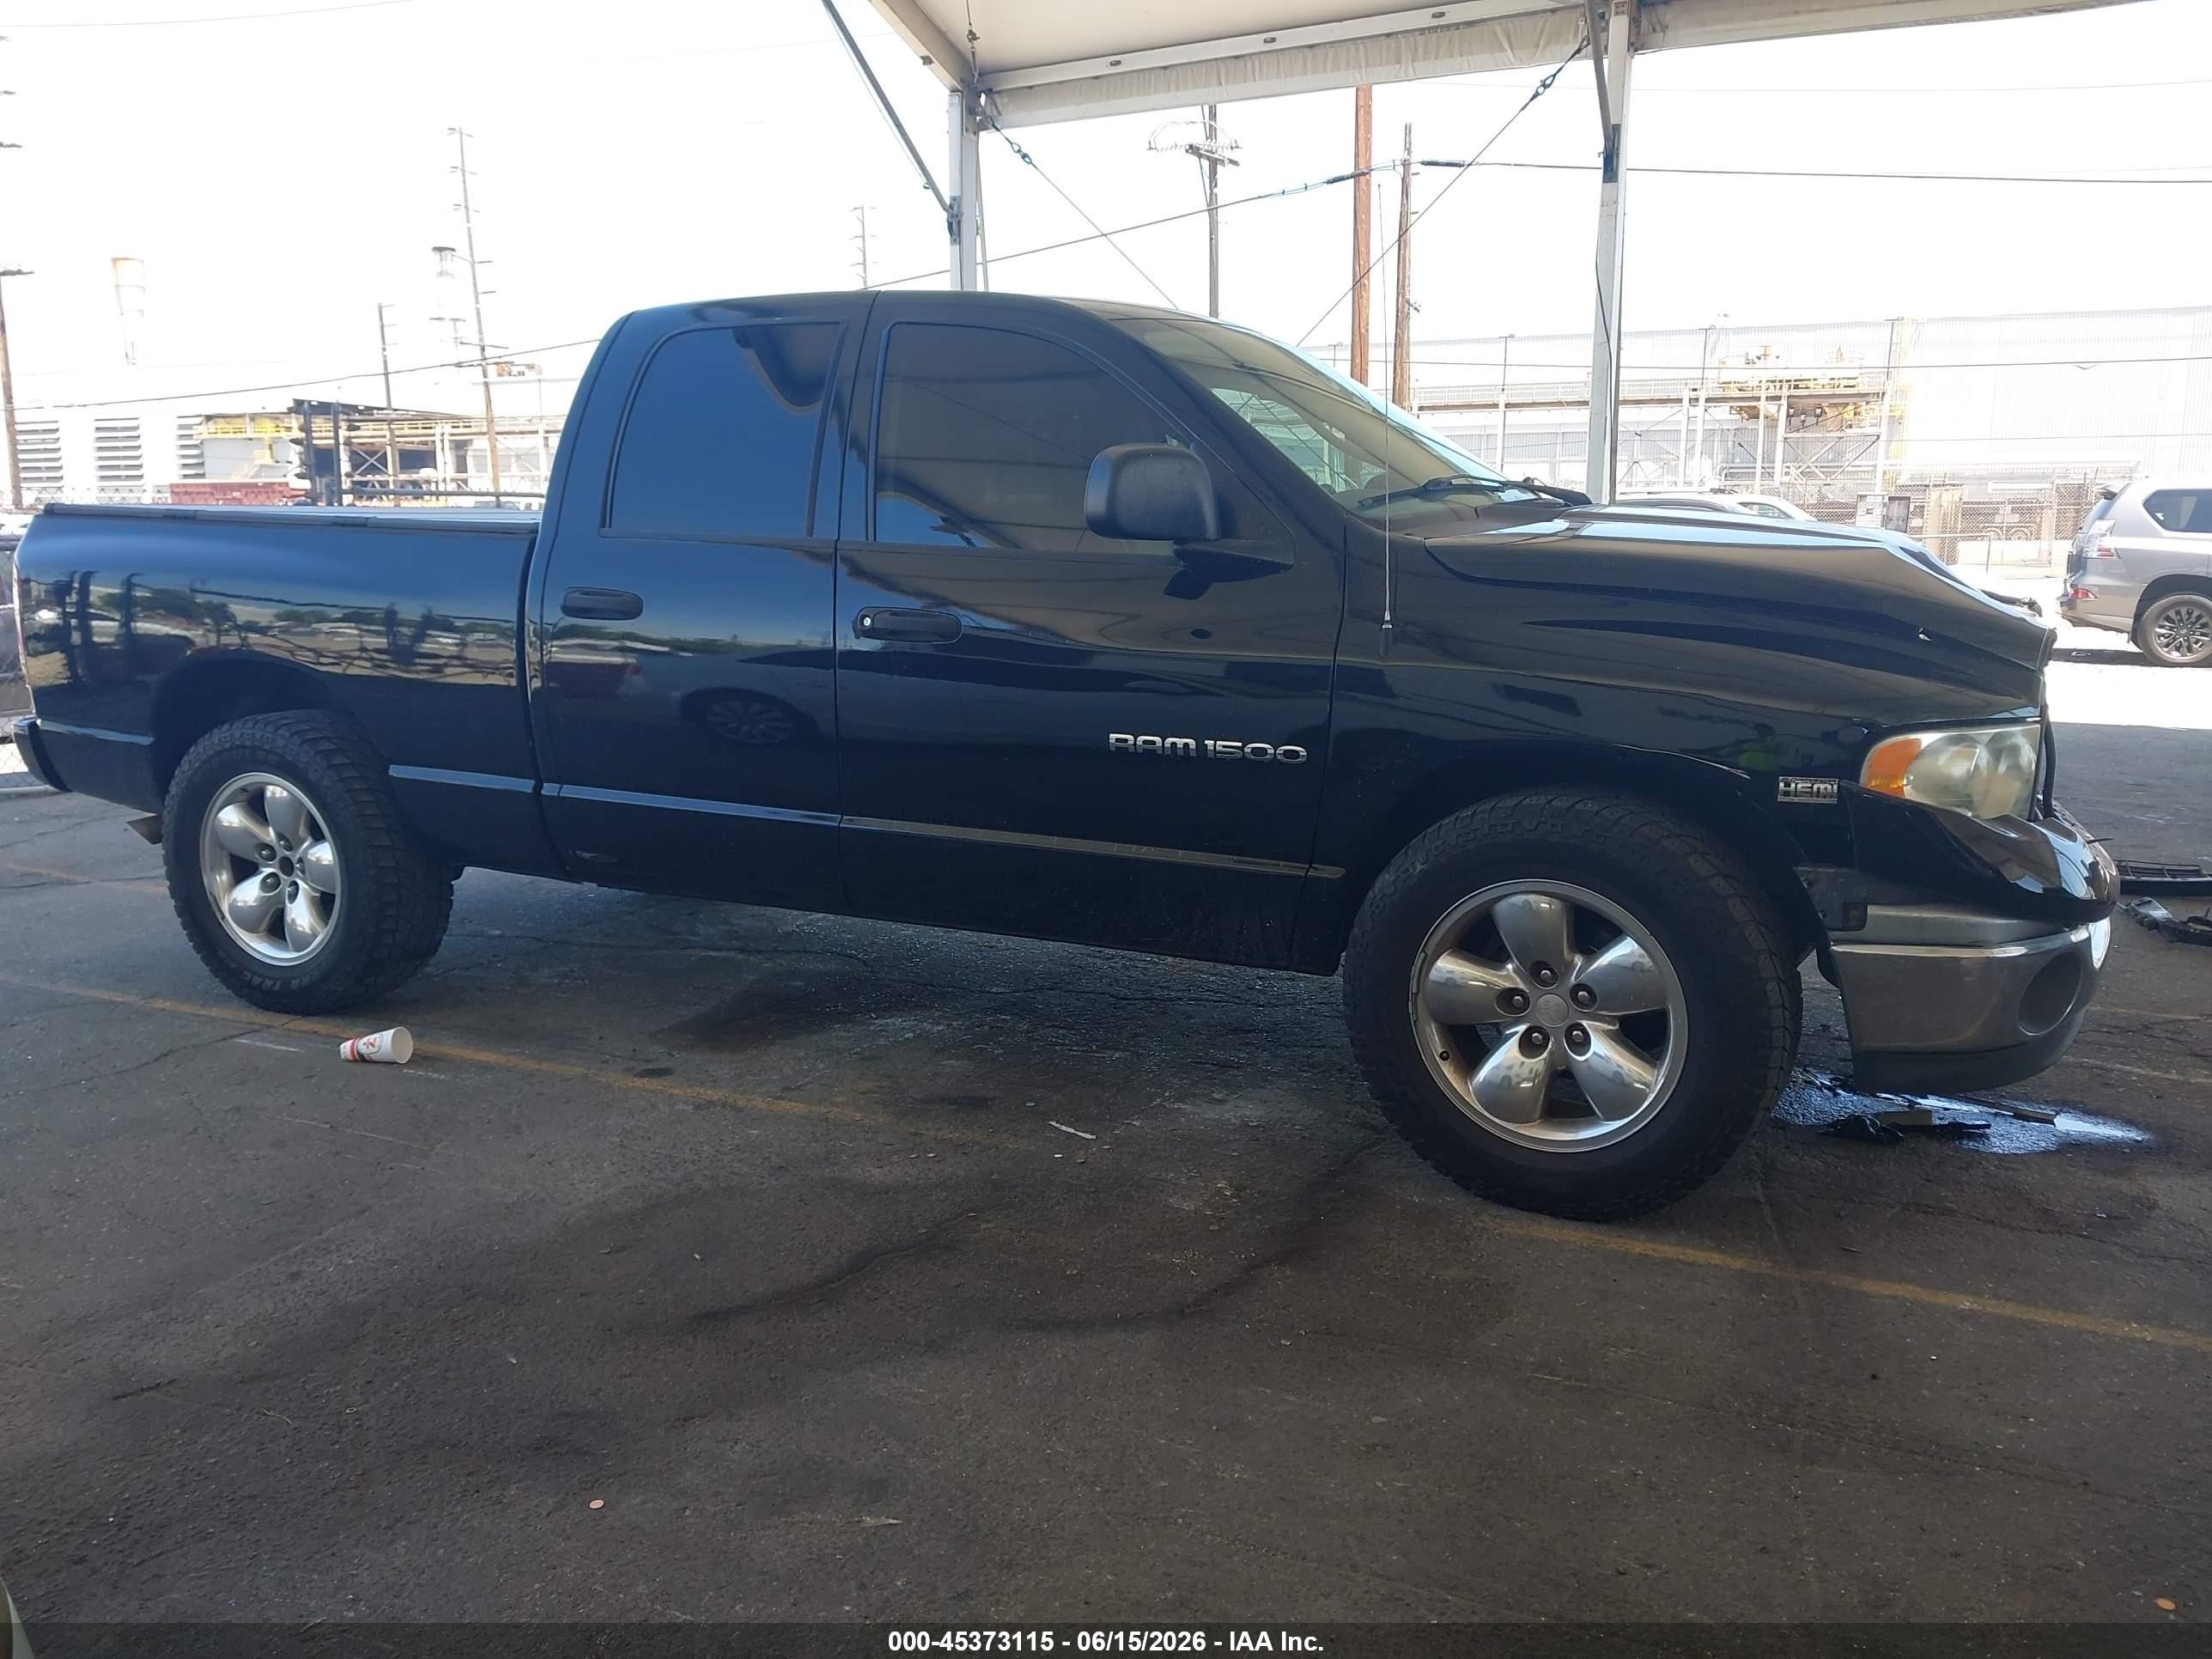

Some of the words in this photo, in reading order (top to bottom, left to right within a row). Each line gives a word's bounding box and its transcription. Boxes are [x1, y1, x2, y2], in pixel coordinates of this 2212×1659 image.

[1109, 733, 1196, 757] RAM
[1204, 739, 1308, 764] 1500
[1778, 781, 1838, 799] HEMI
